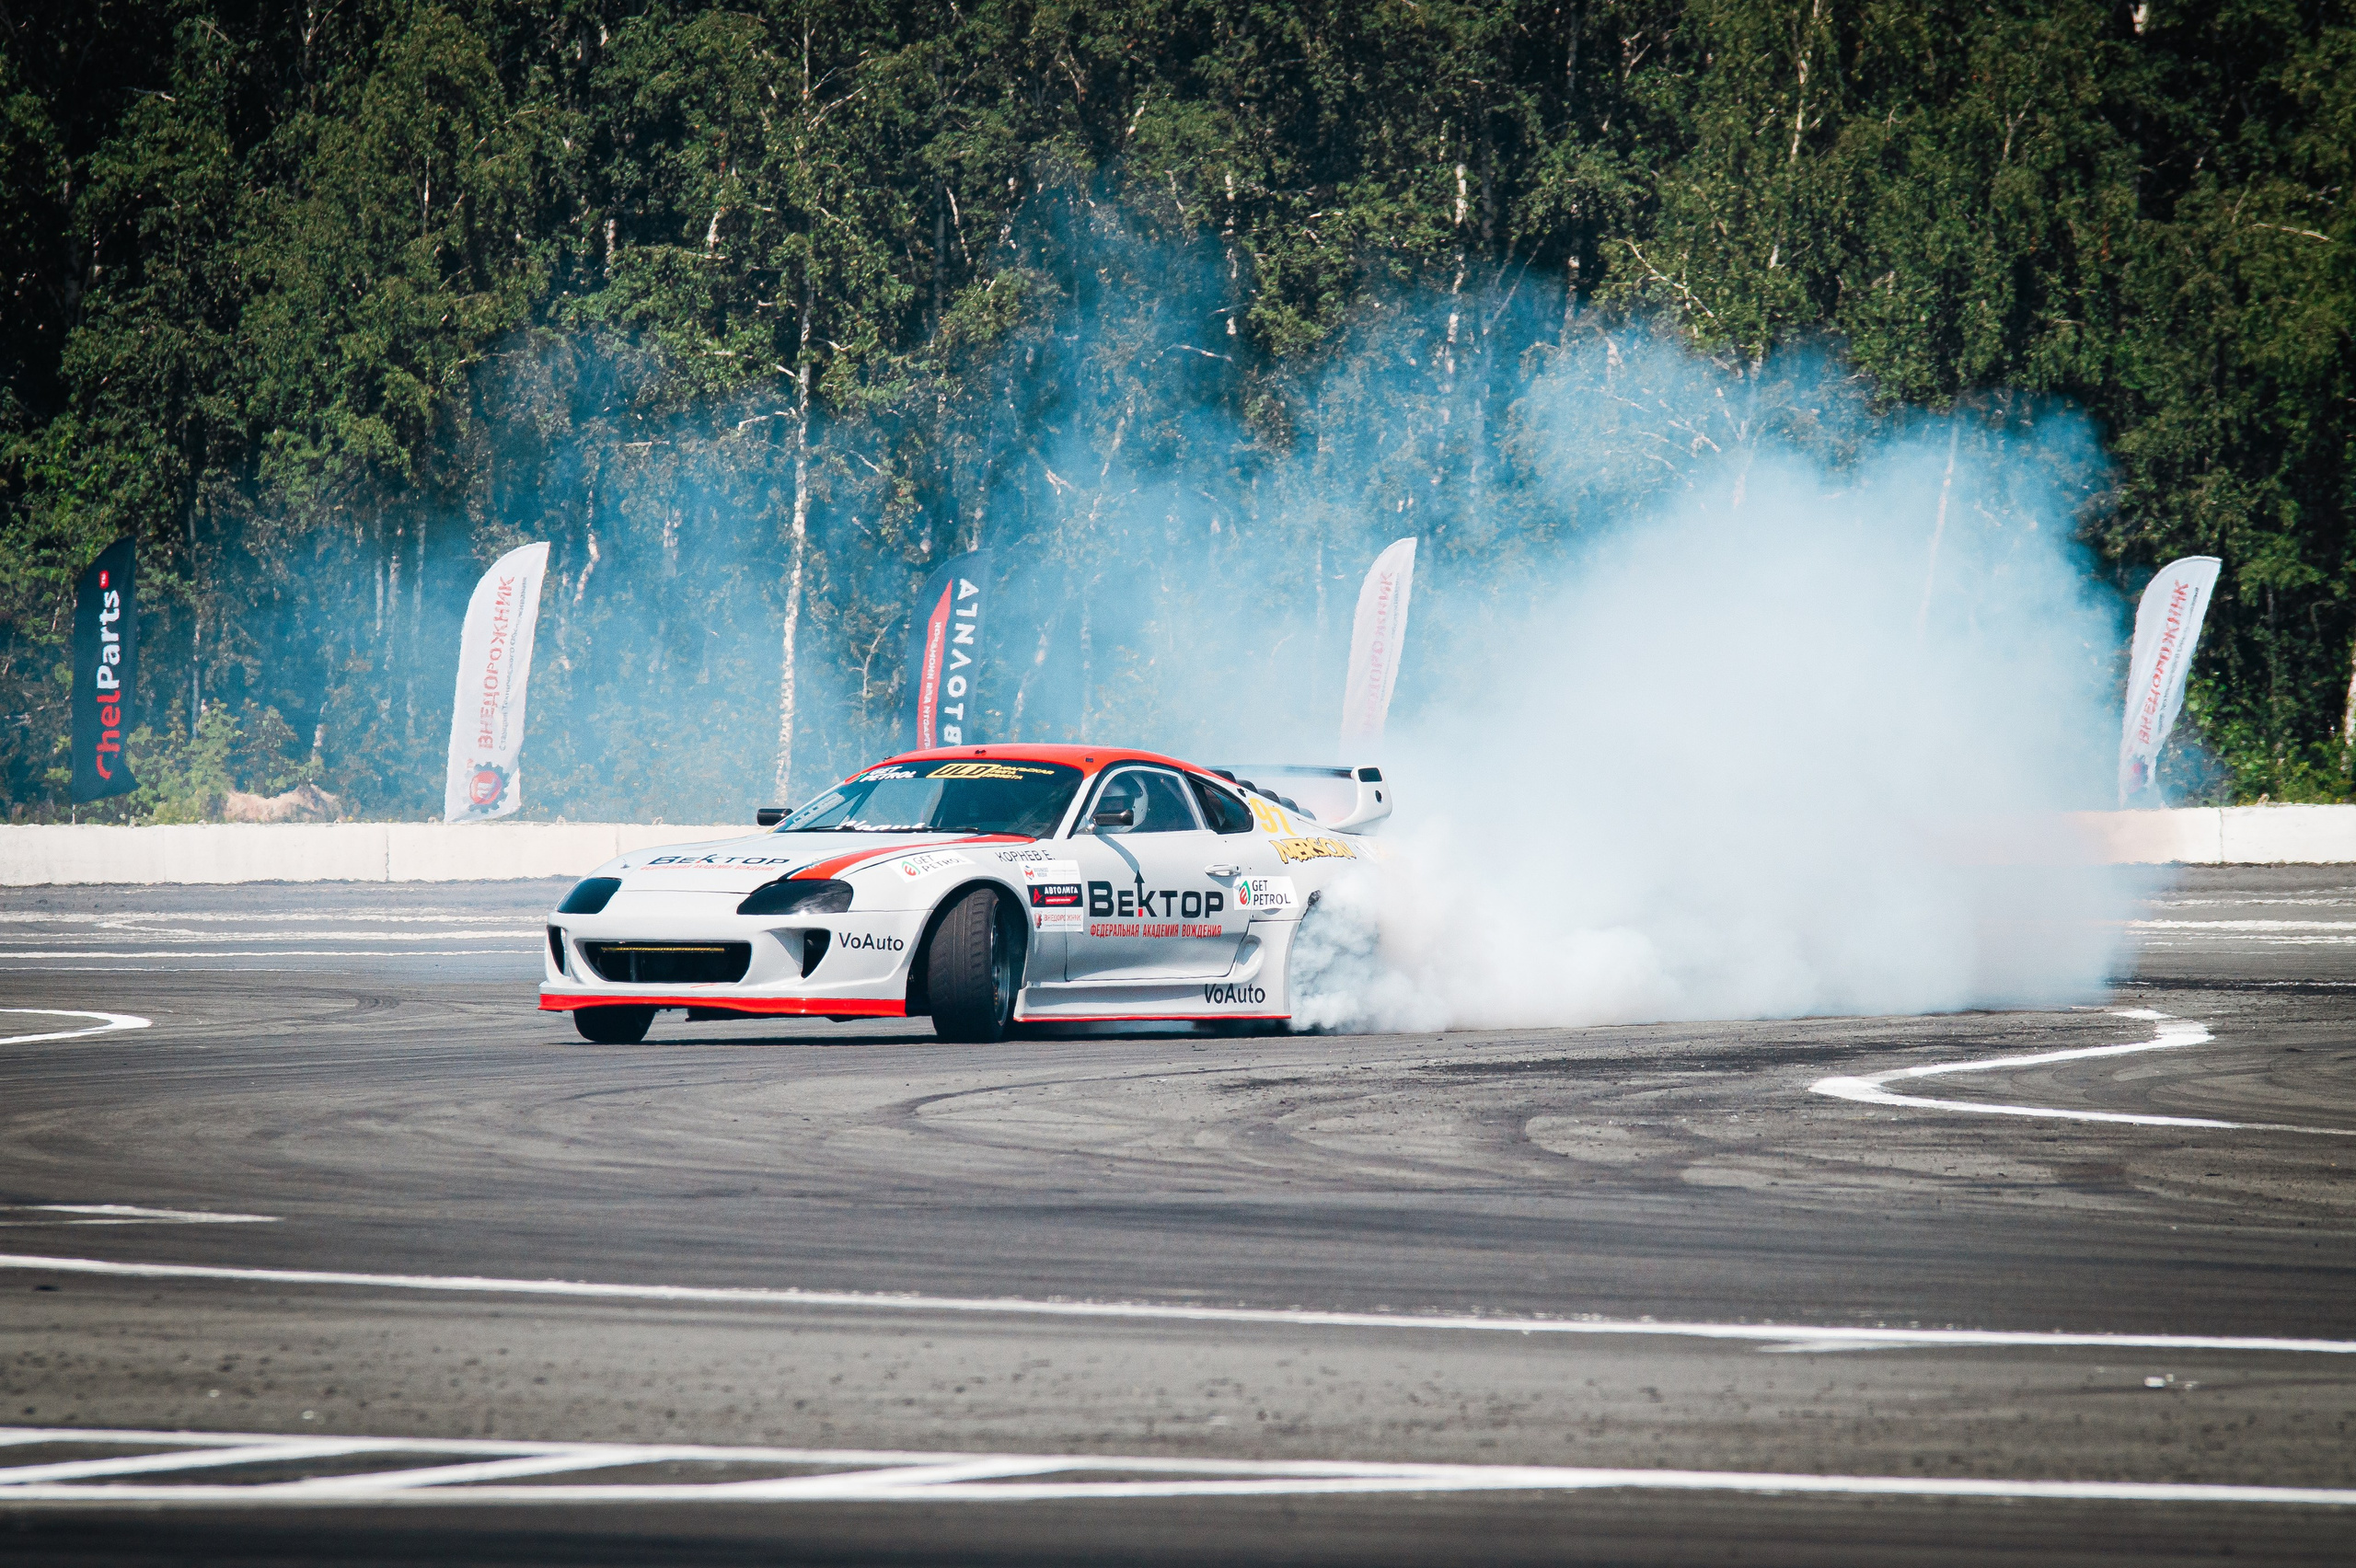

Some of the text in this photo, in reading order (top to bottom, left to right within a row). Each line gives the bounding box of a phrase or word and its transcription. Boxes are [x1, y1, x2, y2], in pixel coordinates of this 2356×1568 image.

[478, 576, 515, 750] ВНЕДОРОЖНИК
[913, 854, 935, 865] GET
[994, 849, 1043, 862] КОРНЕВ
[921, 857, 966, 872] PETROL
[1044, 886, 1079, 894] АВТОЛИГА
[1252, 880, 1268, 892] GET
[1253, 894, 1292, 906] PETROL
[1090, 923, 1222, 939] ФЕДЕРАЛЬНАЯ АКАДЕМИЯ ВОЖДЕНИЯ
[838, 931, 905, 951] VoAuto
[1204, 983, 1266, 1004] VoAuto
